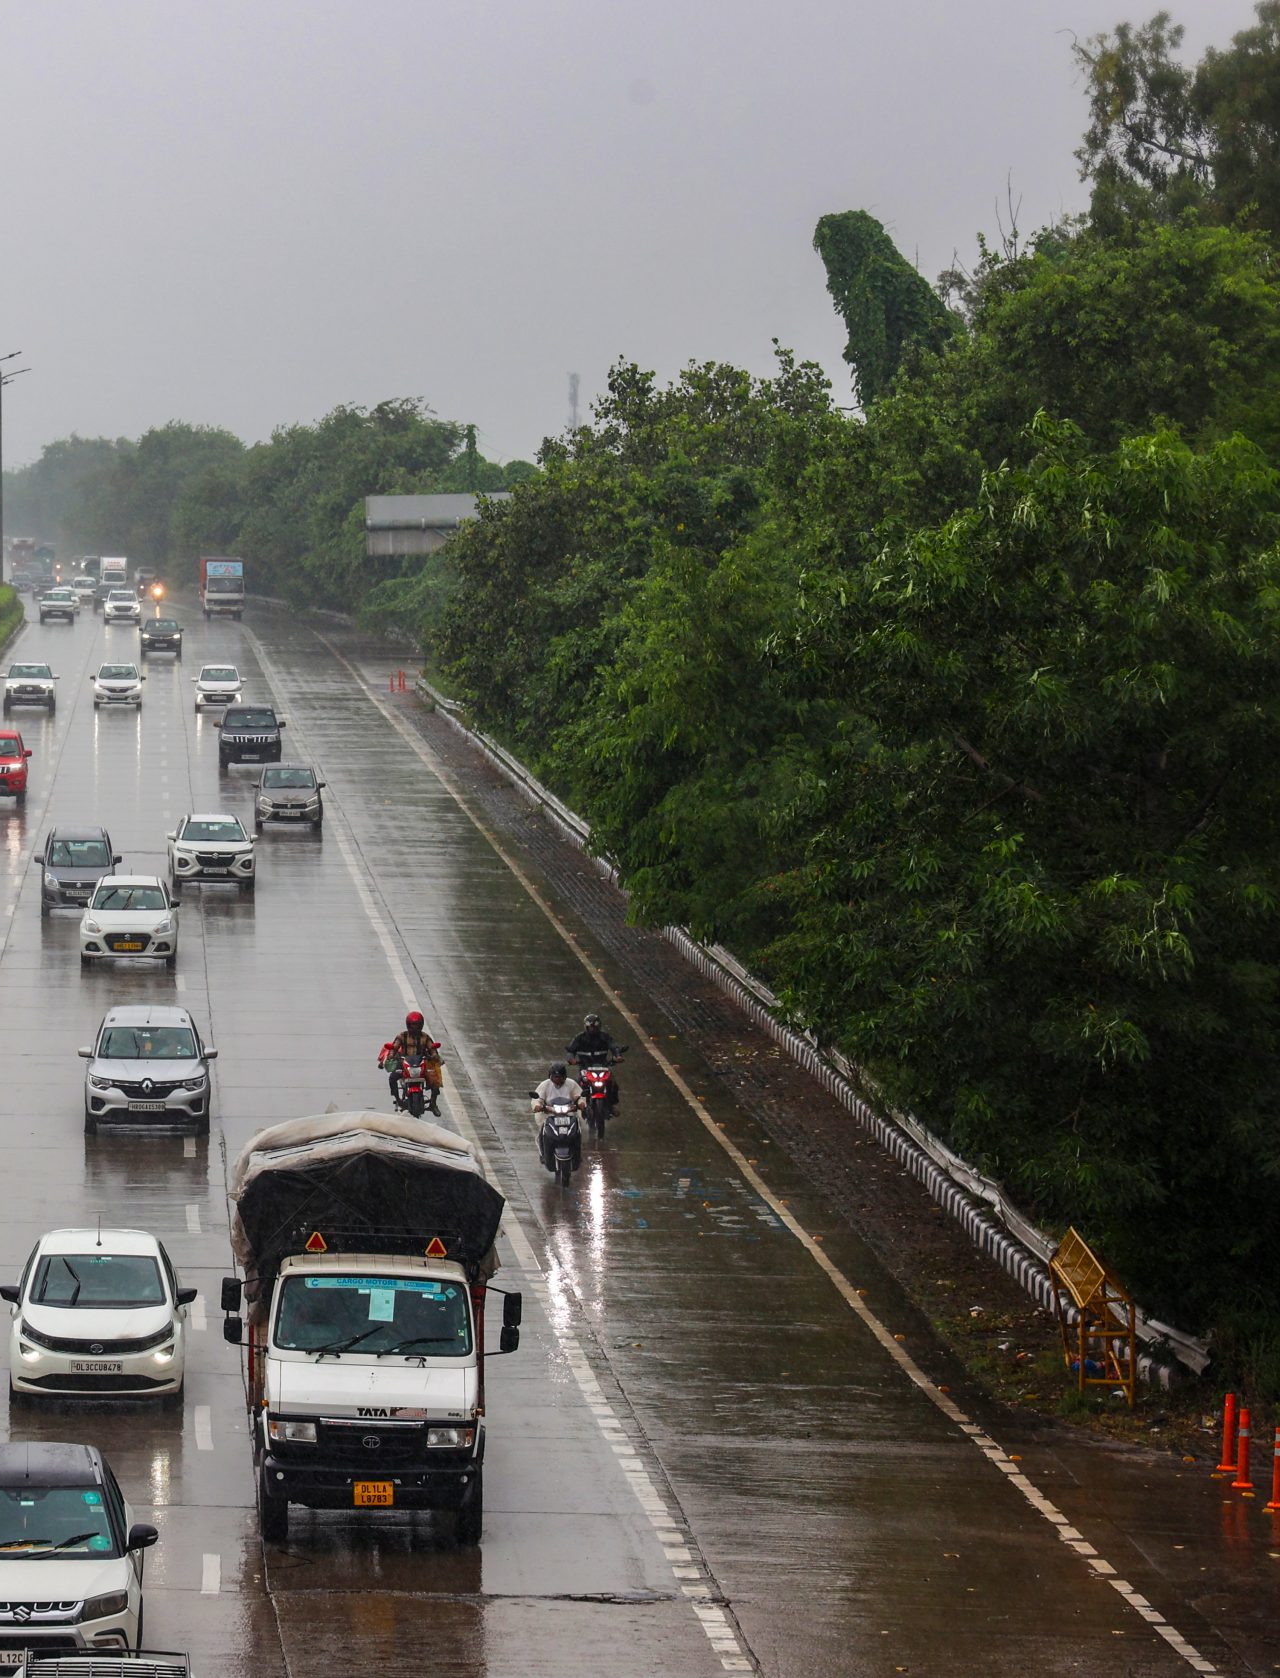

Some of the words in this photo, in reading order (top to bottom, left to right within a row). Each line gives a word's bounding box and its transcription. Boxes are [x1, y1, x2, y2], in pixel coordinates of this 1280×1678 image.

[76, 1363, 121, 1371] DL3CCU8478
[357, 1407, 387, 1417] TATA
[361, 1484, 387, 1493] DL1LA
